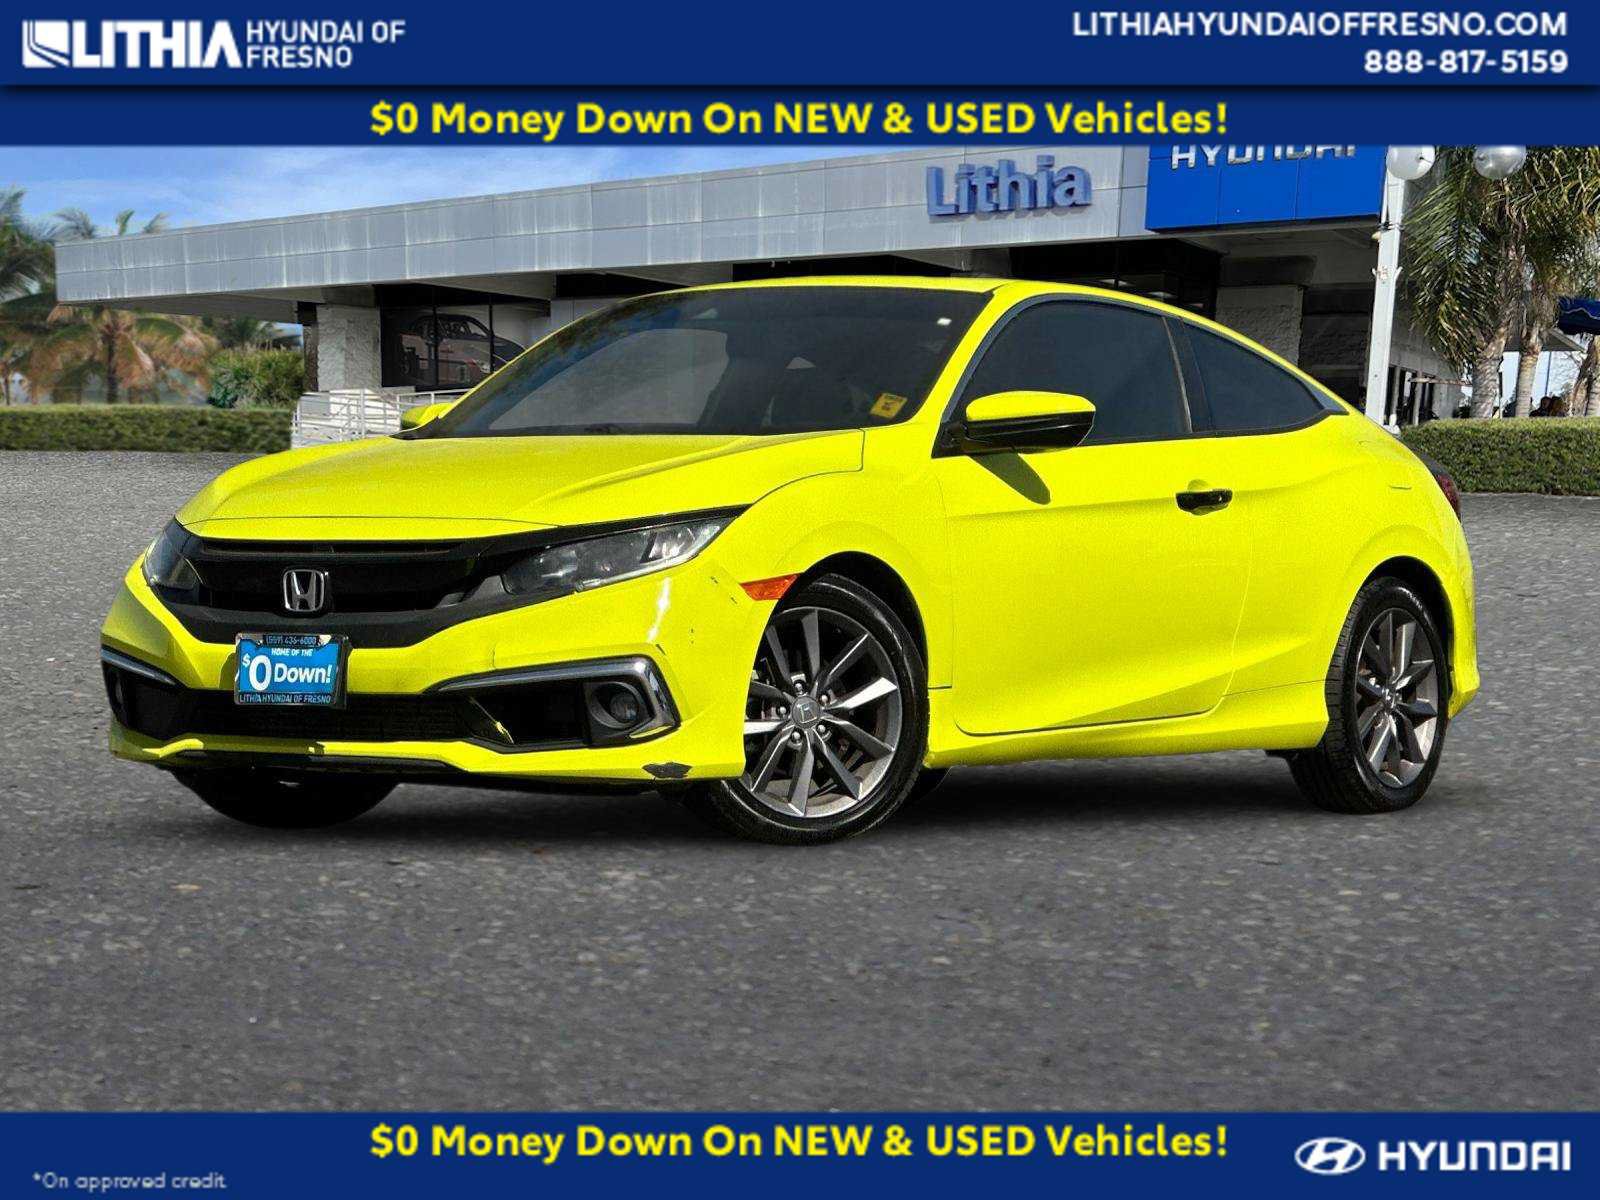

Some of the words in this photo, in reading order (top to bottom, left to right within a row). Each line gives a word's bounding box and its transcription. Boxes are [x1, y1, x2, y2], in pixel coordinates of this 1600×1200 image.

[926, 154, 1092, 216] Lithia
[271, 648, 290, 656] HOME
[291, 648, 300, 656] OF
[301, 648, 314, 656] THE
[274, 663, 333, 684] Down!
[293, 694, 303, 704] OF
[303, 695, 332, 705] FRESNO
